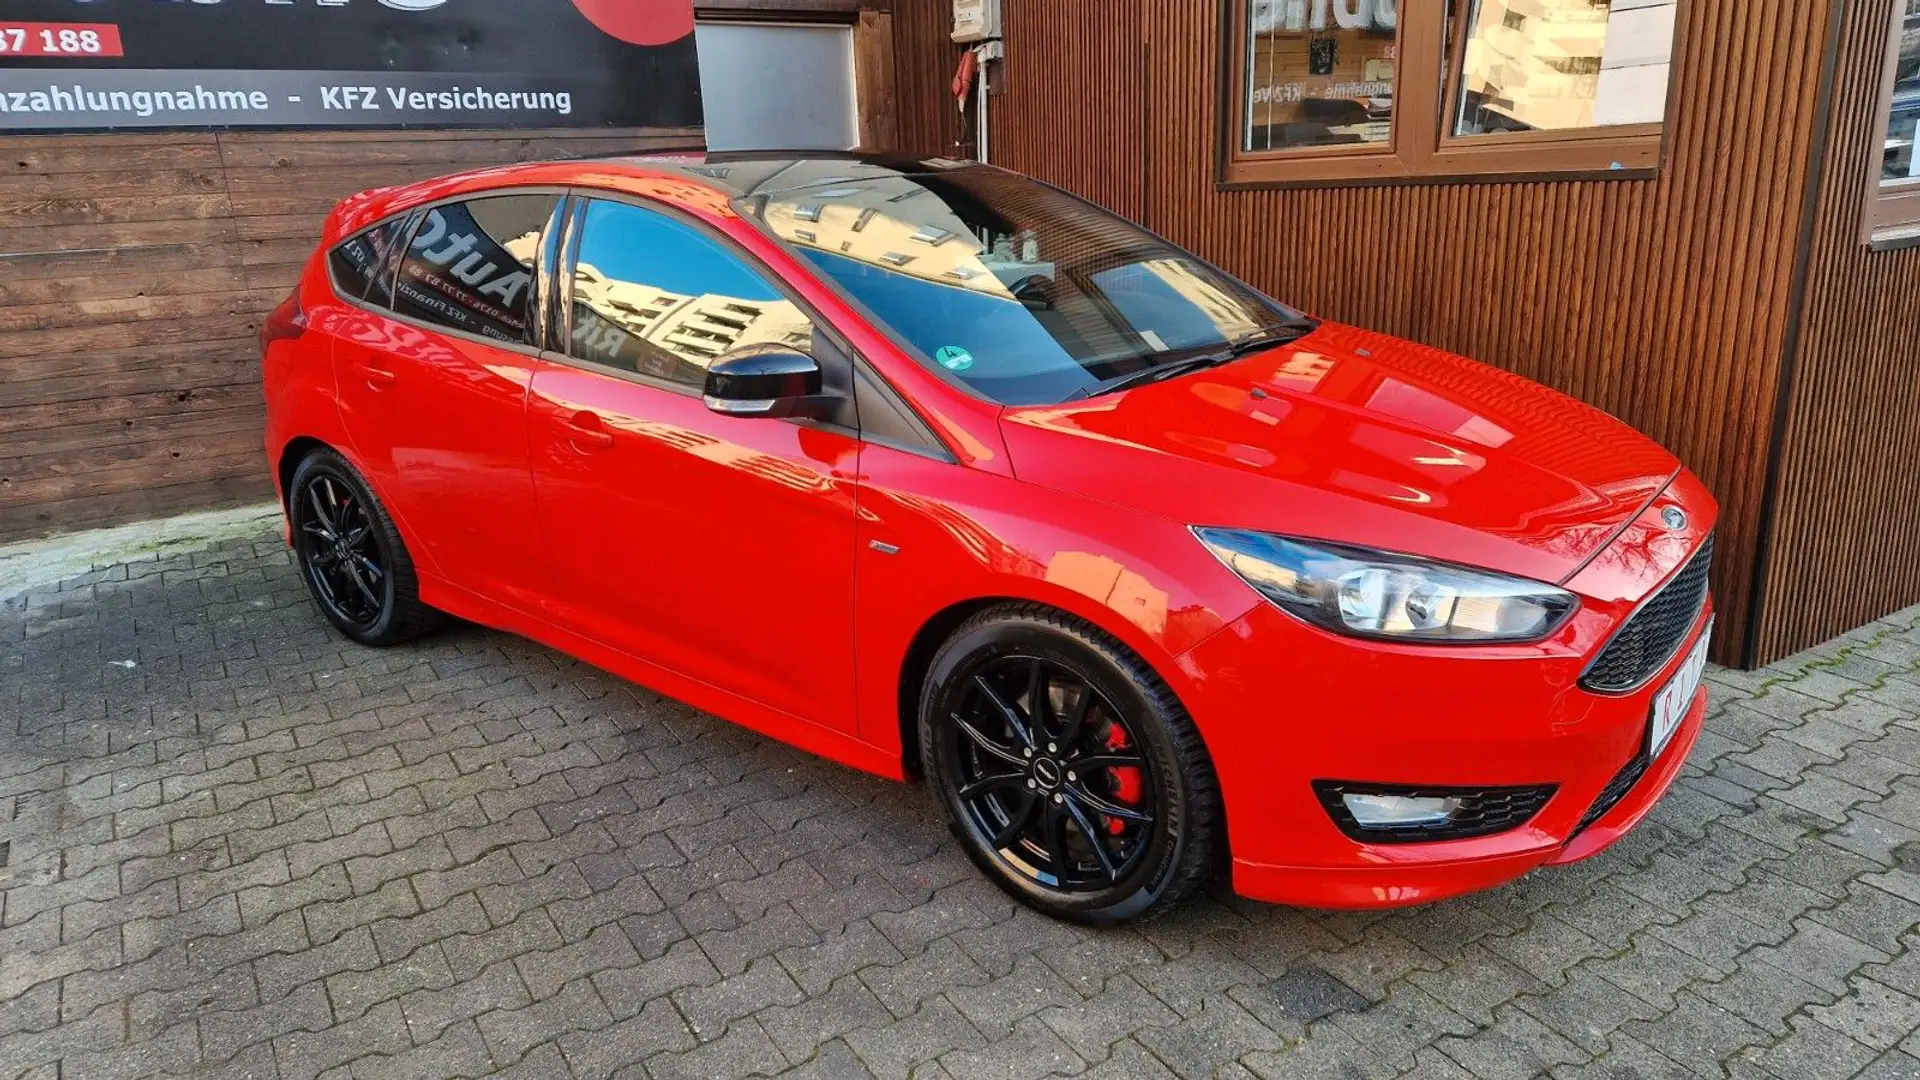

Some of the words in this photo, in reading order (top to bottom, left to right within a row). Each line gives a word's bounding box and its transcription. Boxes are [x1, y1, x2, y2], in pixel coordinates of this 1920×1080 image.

[39, 29, 101, 53] 188
[320, 86, 379, 111] KFZ
[386, 86, 572, 114] Versicherung
